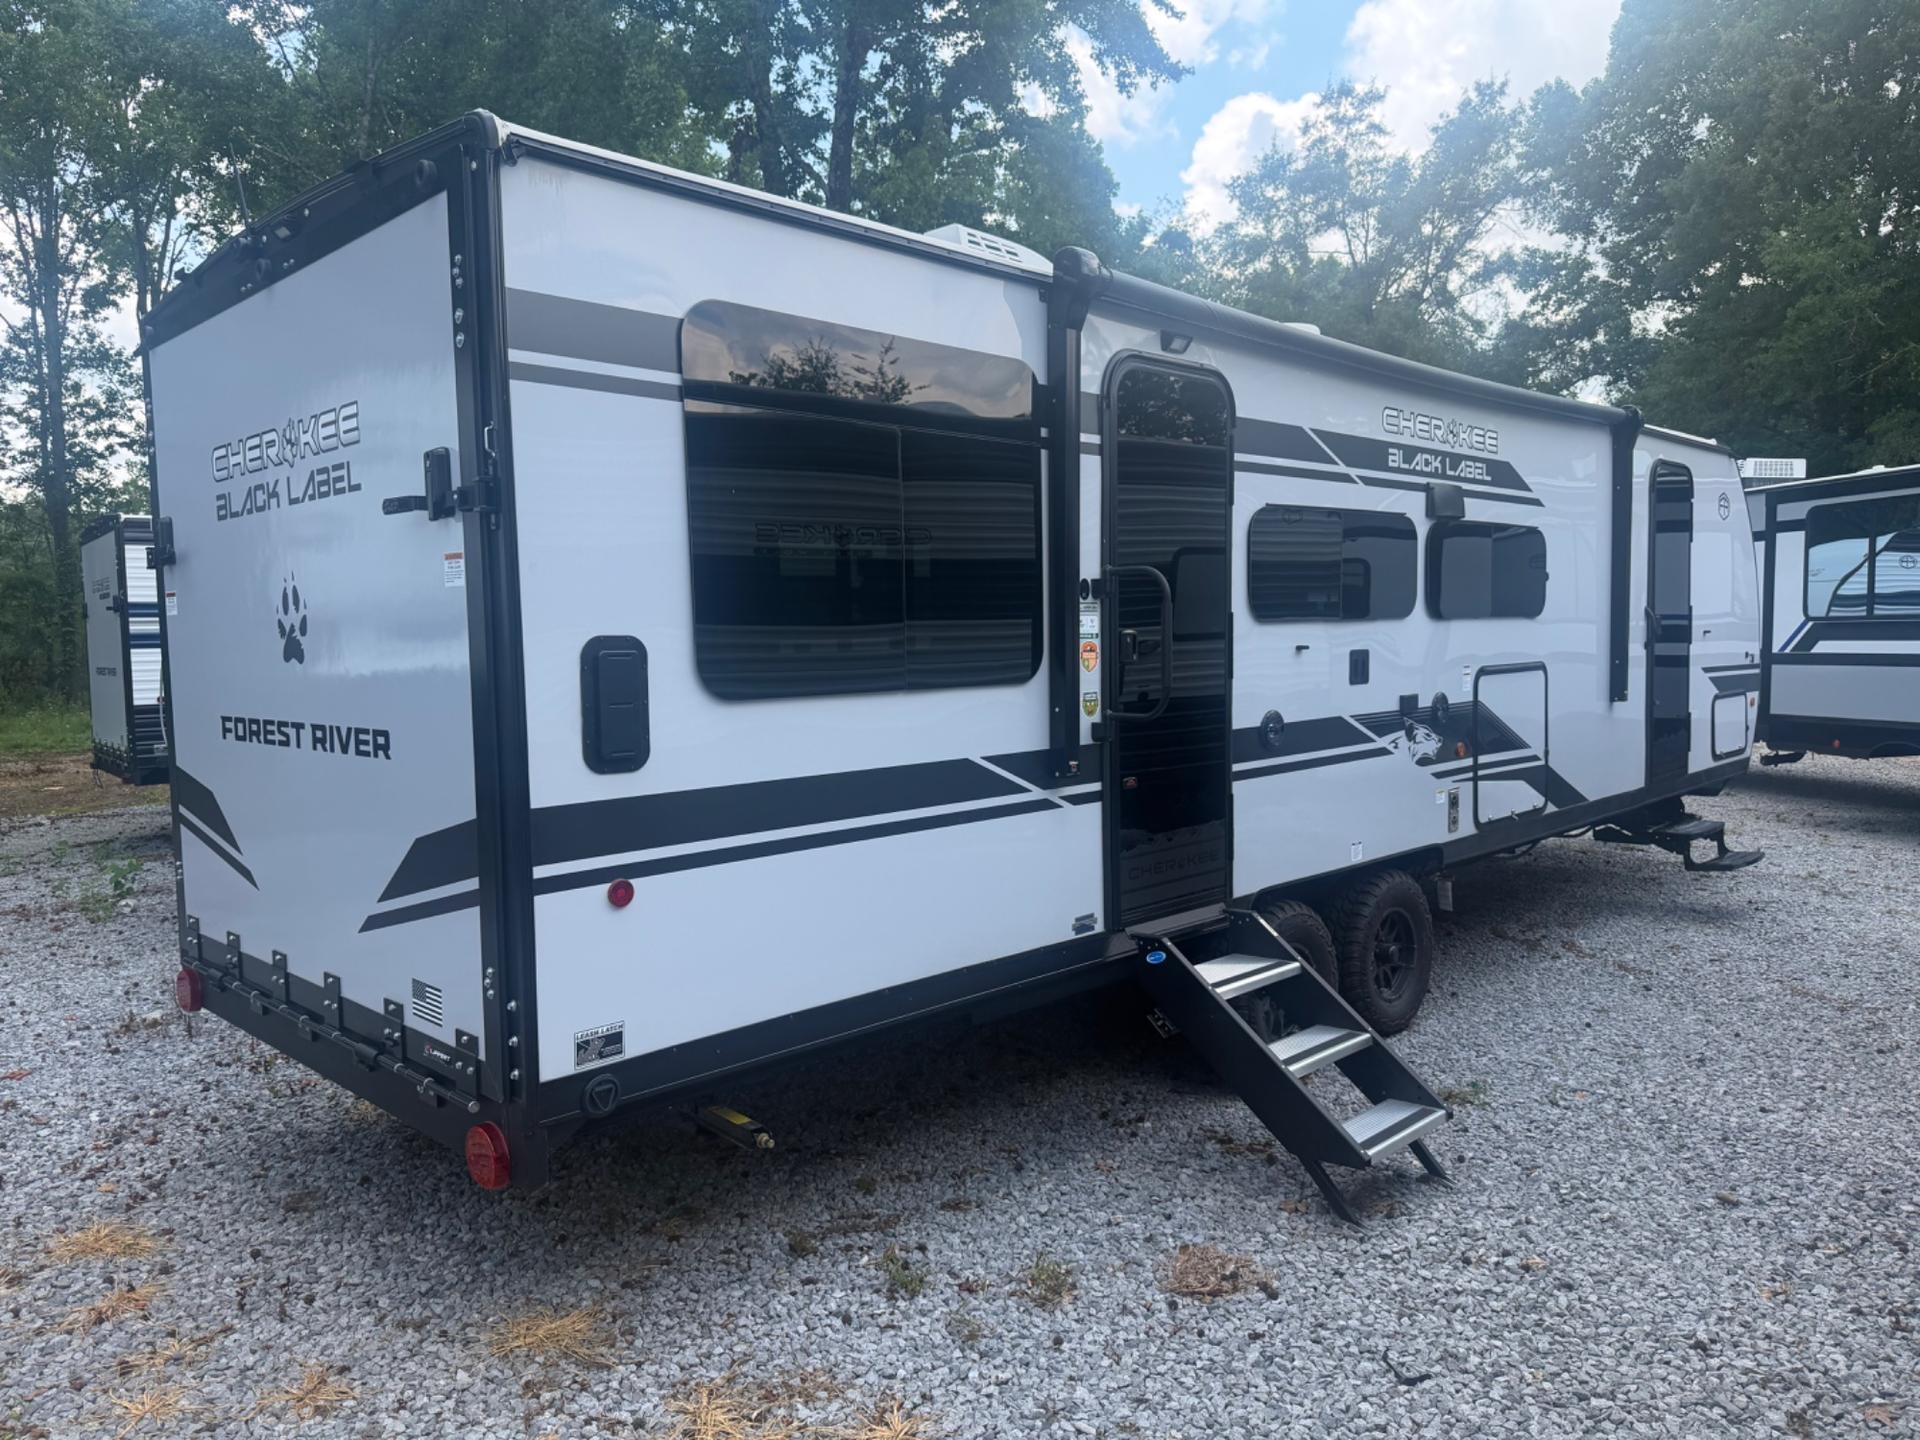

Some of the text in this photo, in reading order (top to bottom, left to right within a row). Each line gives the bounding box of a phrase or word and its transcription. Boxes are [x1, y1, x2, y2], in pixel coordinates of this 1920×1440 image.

[1388, 448, 1492, 481] BLACK LABEL
[216, 461, 361, 521] BLACK LABEL
[220, 715, 391, 760] FOREST RIVER
